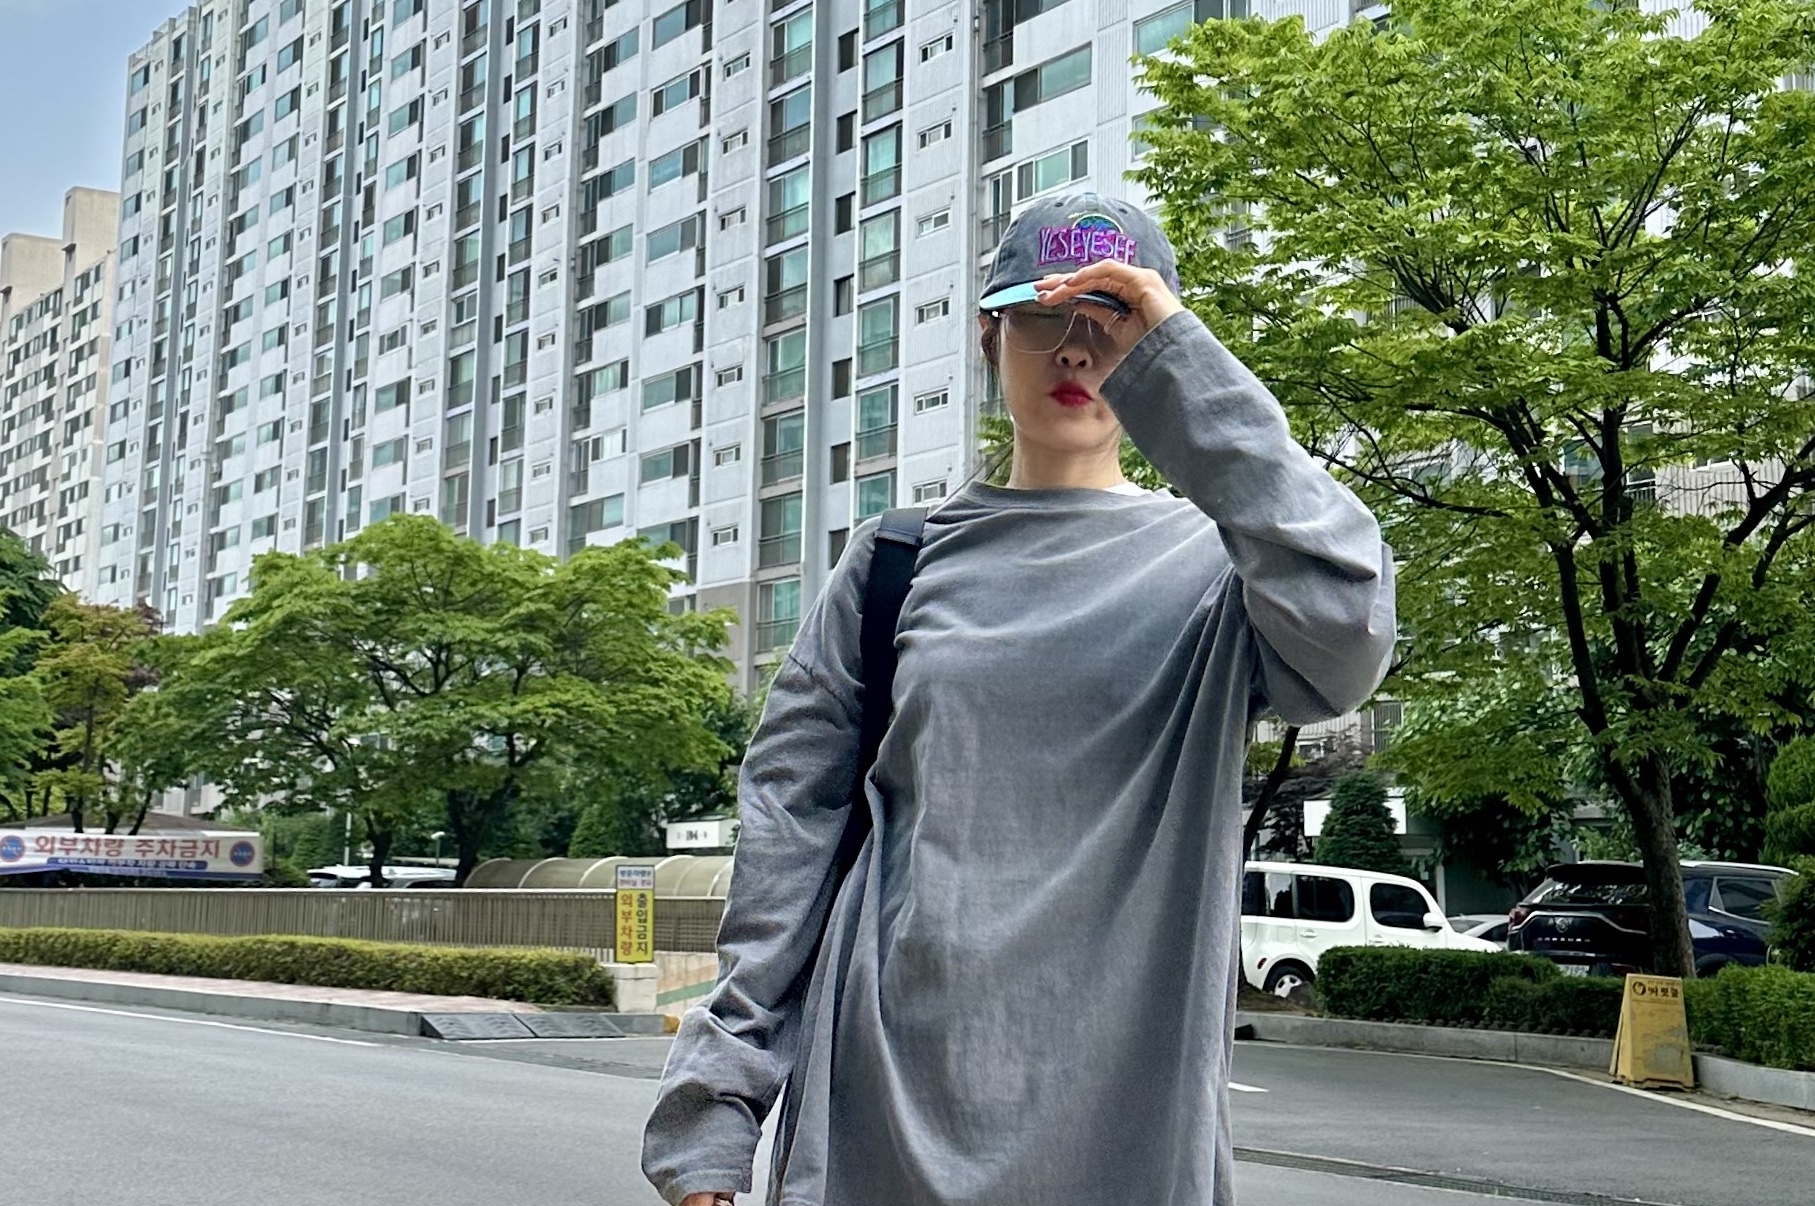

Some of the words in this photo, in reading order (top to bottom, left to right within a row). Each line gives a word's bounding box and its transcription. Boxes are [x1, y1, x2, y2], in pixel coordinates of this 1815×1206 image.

[34, 835, 125, 858] 외부차량
[134, 838, 220, 859] 주차금지
[620, 893, 633, 956] 외부차량
[636, 892, 648, 955] 출입금지
